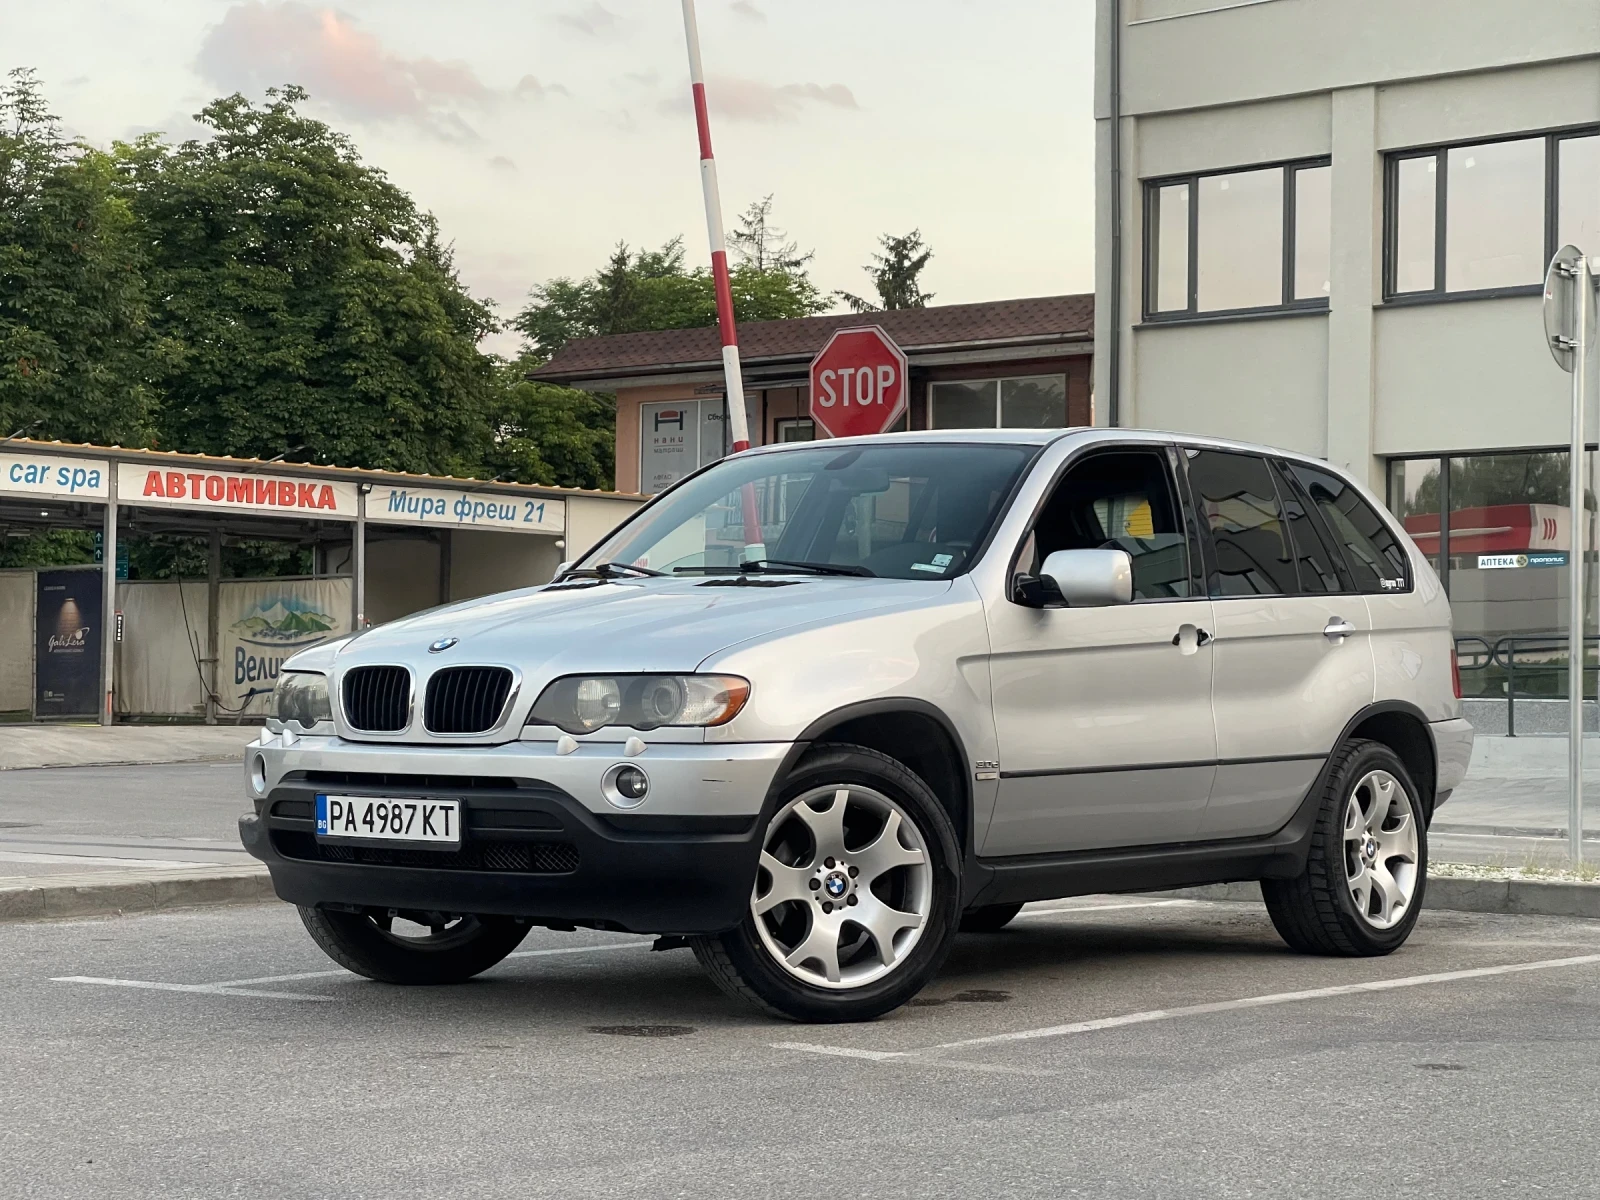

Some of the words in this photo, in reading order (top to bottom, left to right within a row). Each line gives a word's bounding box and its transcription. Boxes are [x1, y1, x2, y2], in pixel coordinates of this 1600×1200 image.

[819, 365, 895, 408] STOP
[9, 462, 50, 484] car
[56, 466, 101, 492] spa
[143, 470, 337, 510] АВТОМИВКА
[387, 490, 446, 519] Мира
[453, 495, 517, 522] фреш
[523, 501, 546, 524] 21
[1480, 558, 1514, 566] АПТЕКА
[317, 820, 327, 829] BG
